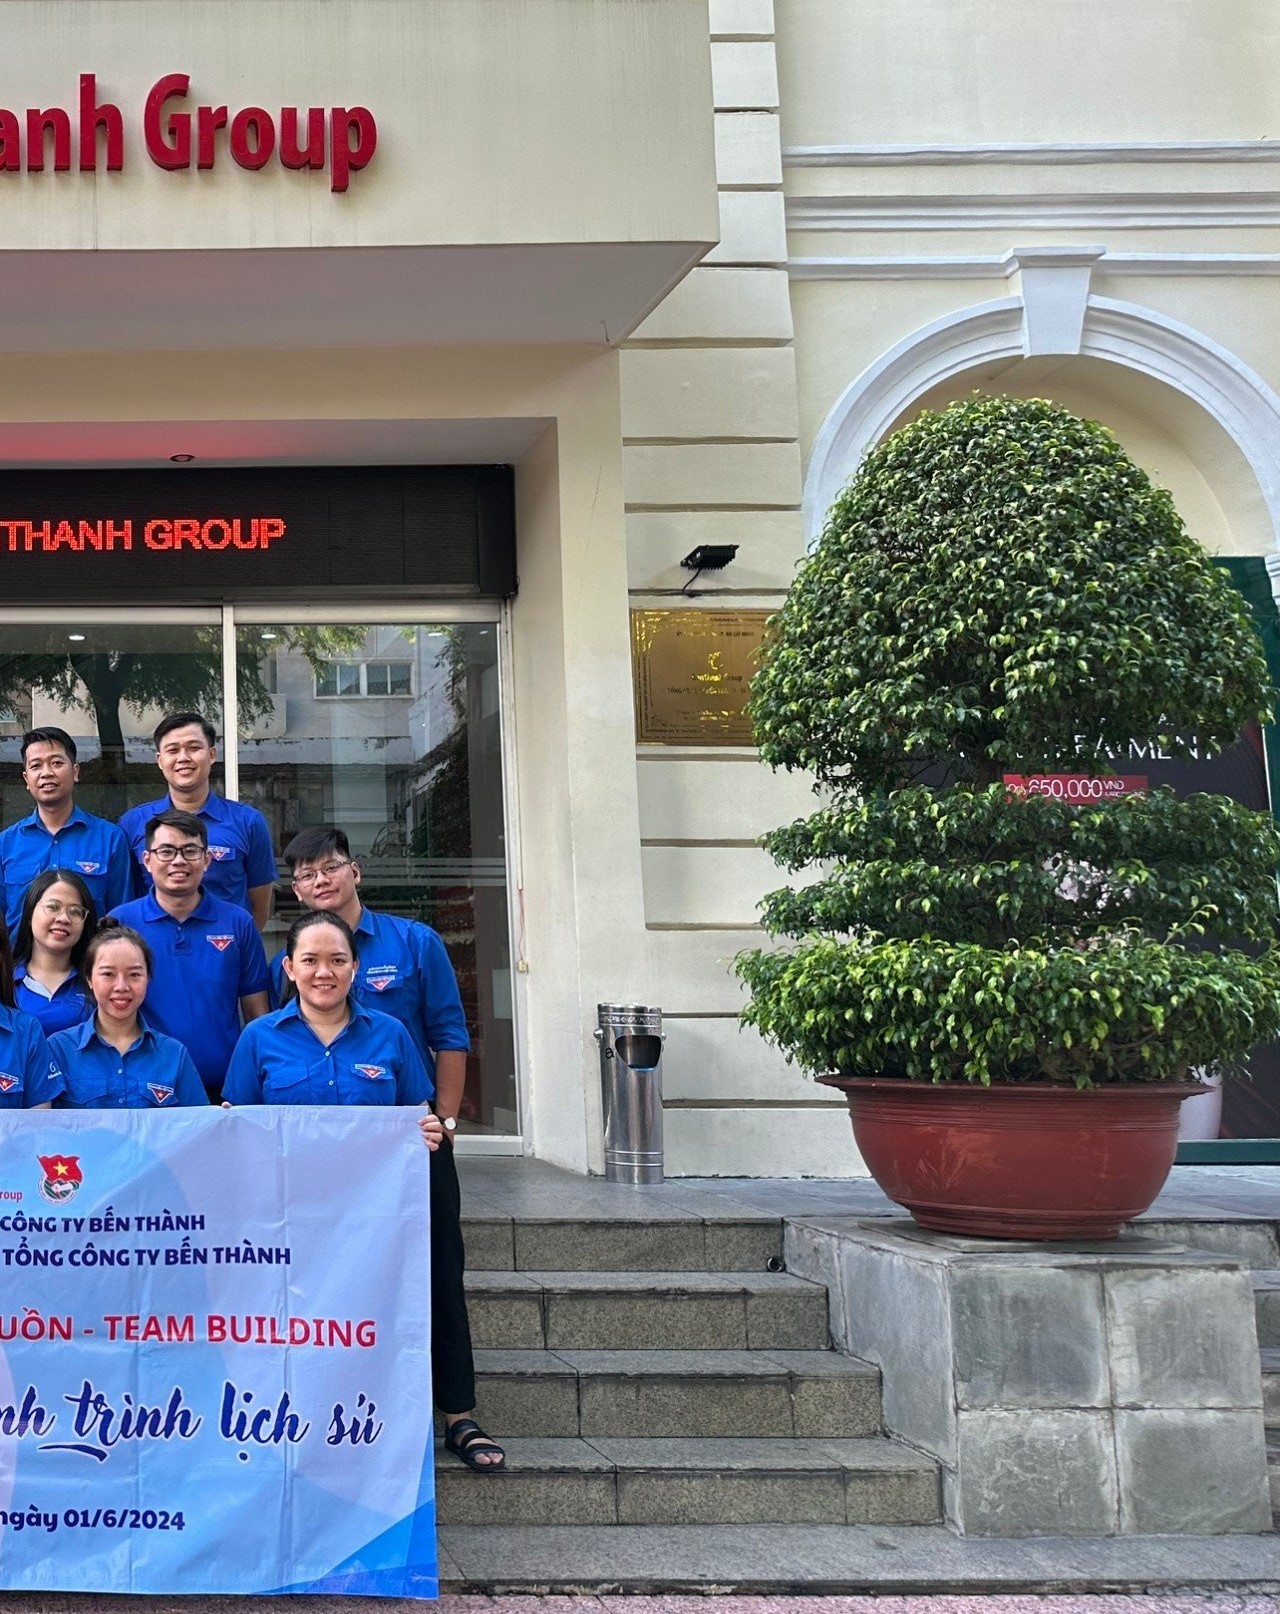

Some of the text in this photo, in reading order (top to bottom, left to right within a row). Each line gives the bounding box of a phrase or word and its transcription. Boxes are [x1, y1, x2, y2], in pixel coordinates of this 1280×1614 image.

[143, 72, 378, 191] Group
[143, 518, 287, 550] GROUP
[0, 1210, 57, 1233] CÔNG
[61, 1217, 86, 1233] TY
[89, 1205, 130, 1233] BẾN
[134, 1208, 205, 1232] THÀNH
[2, 1236, 64, 1267] TỔNG
[68, 1242, 130, 1267] CÔNG
[134, 1249, 161, 1266] TY
[164, 1235, 208, 1266] BẾN
[212, 1238, 291, 1265] THÀNH
[103, 1314, 196, 1342] TEAM
[207, 1315, 376, 1348] BUILDING
[58, 1381, 203, 1460] trình
[220, 1381, 310, 1461] lịch
[63, 1509, 185, 1531] 01/6/2024
